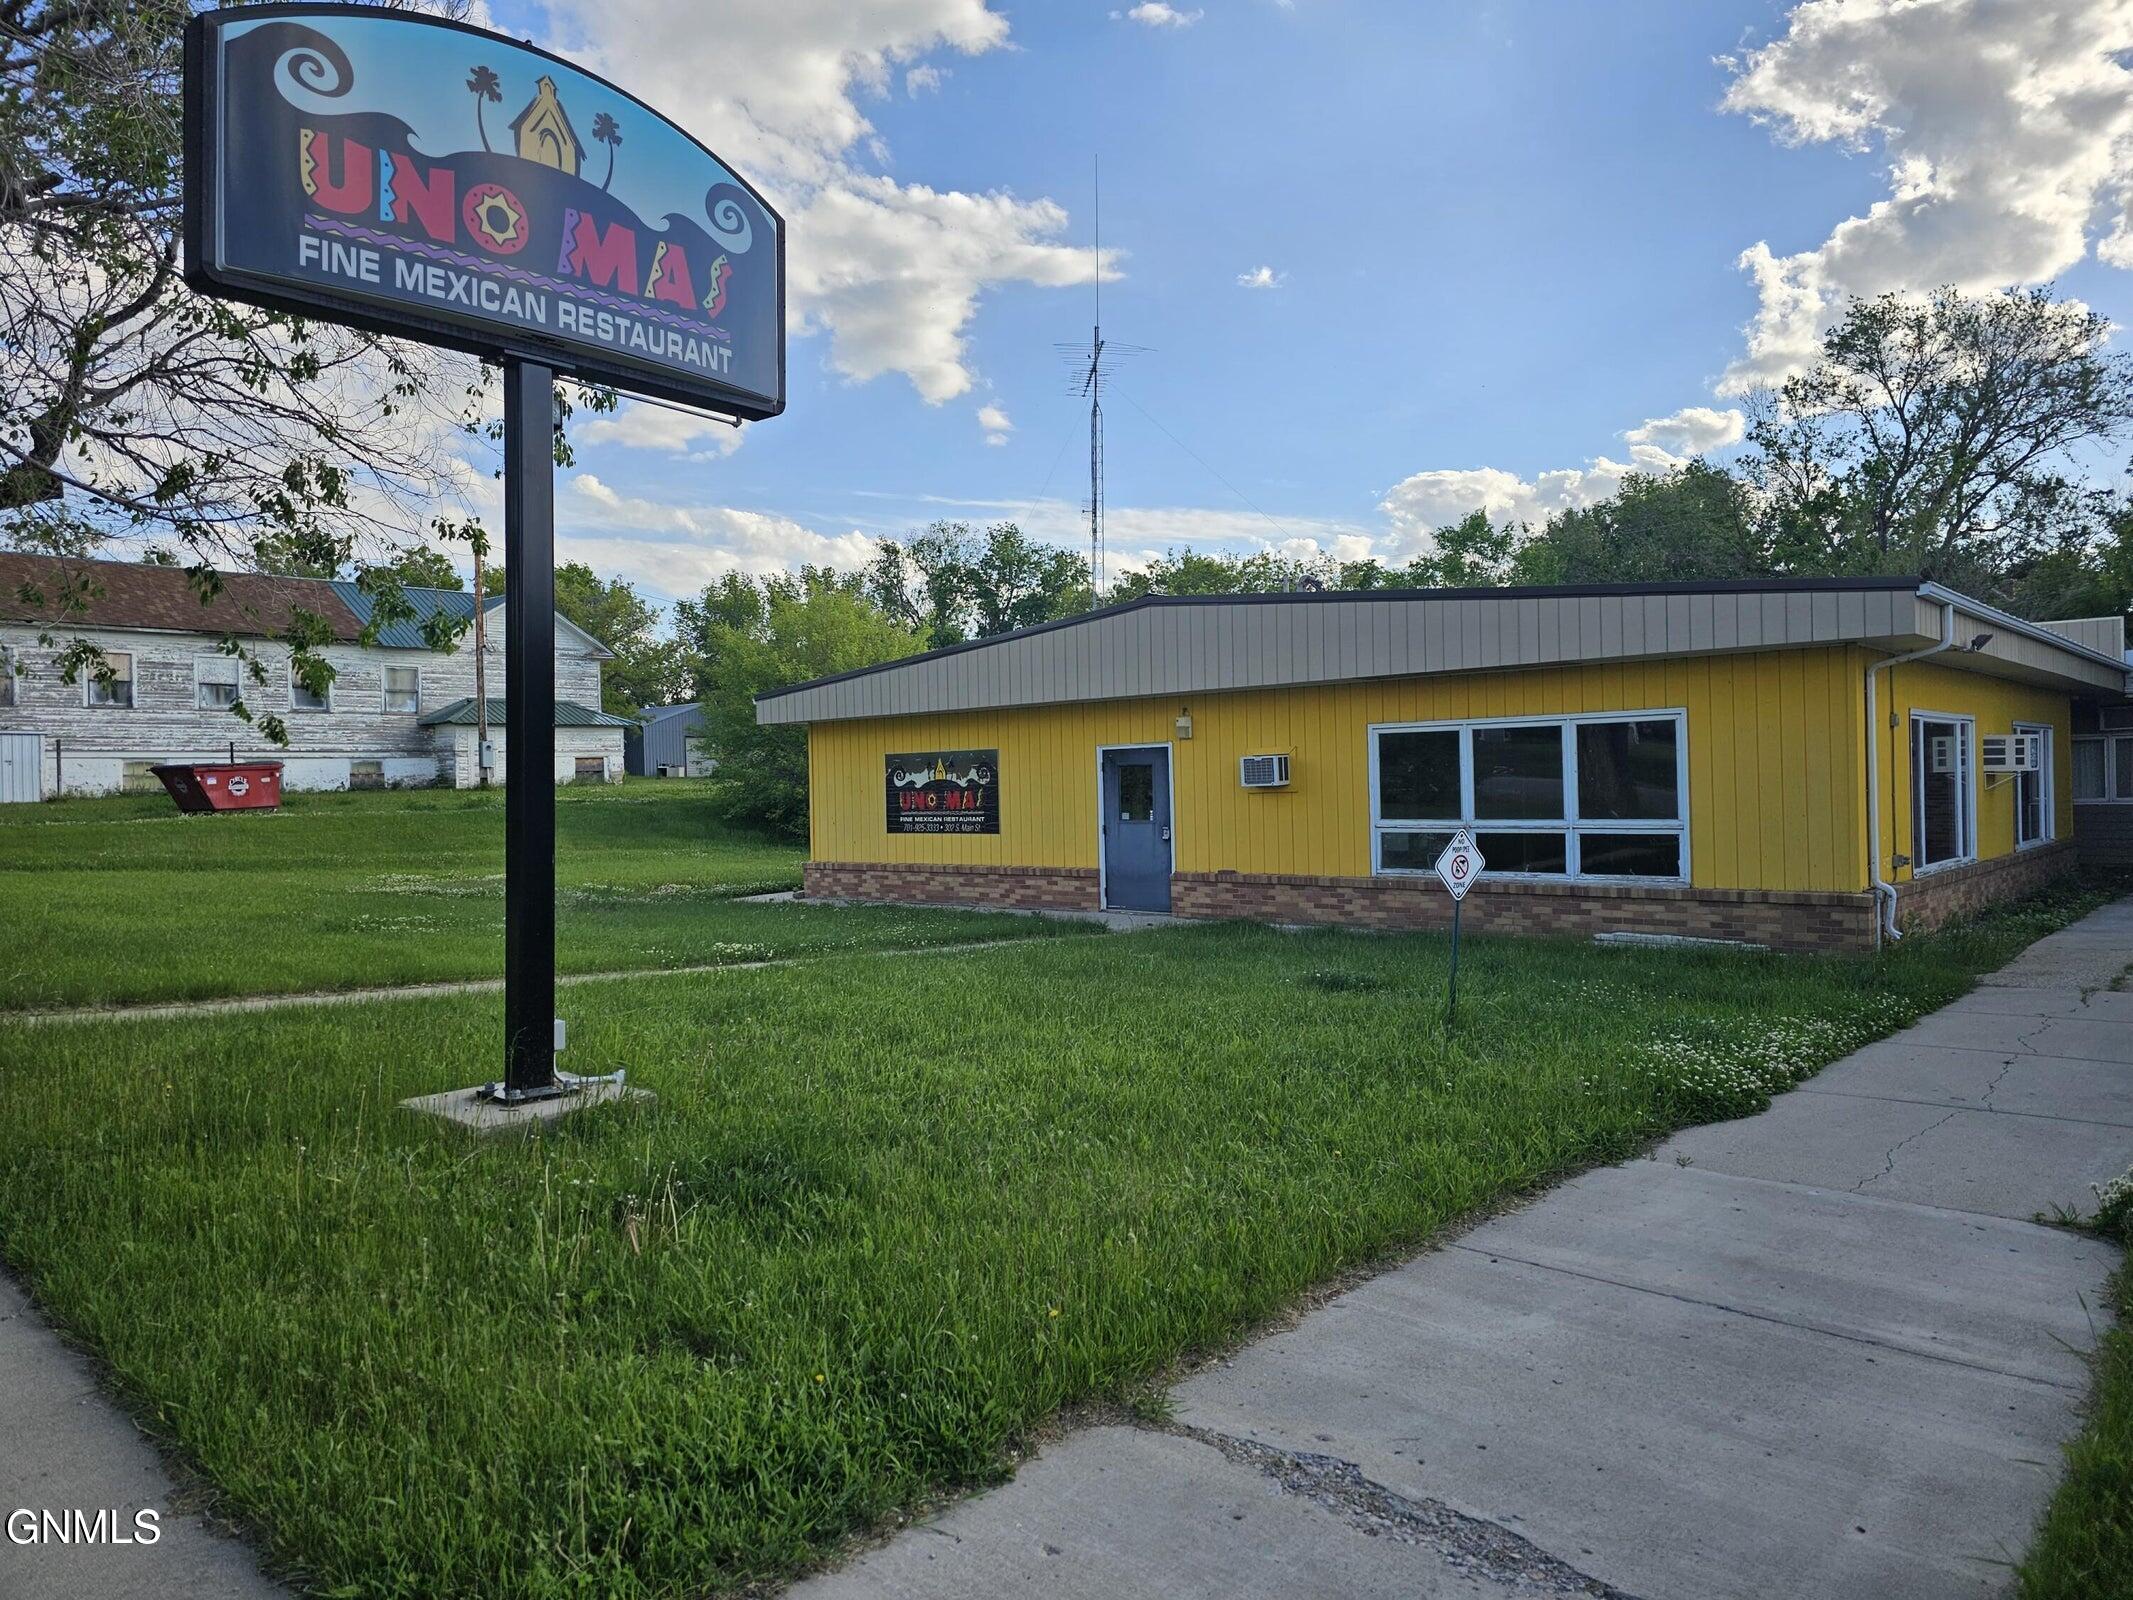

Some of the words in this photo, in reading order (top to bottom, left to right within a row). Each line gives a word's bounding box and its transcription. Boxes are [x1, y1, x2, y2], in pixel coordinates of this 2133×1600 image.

[300, 128, 530, 255] UNO
[557, 207, 735, 319] MAS
[300, 235, 380, 284] FINE
[395, 257, 546, 324] MEXICAN
[558, 299, 734, 375] RESTAURANT
[899, 790, 938, 811] UNO
[961, 823, 974, 832] Main
